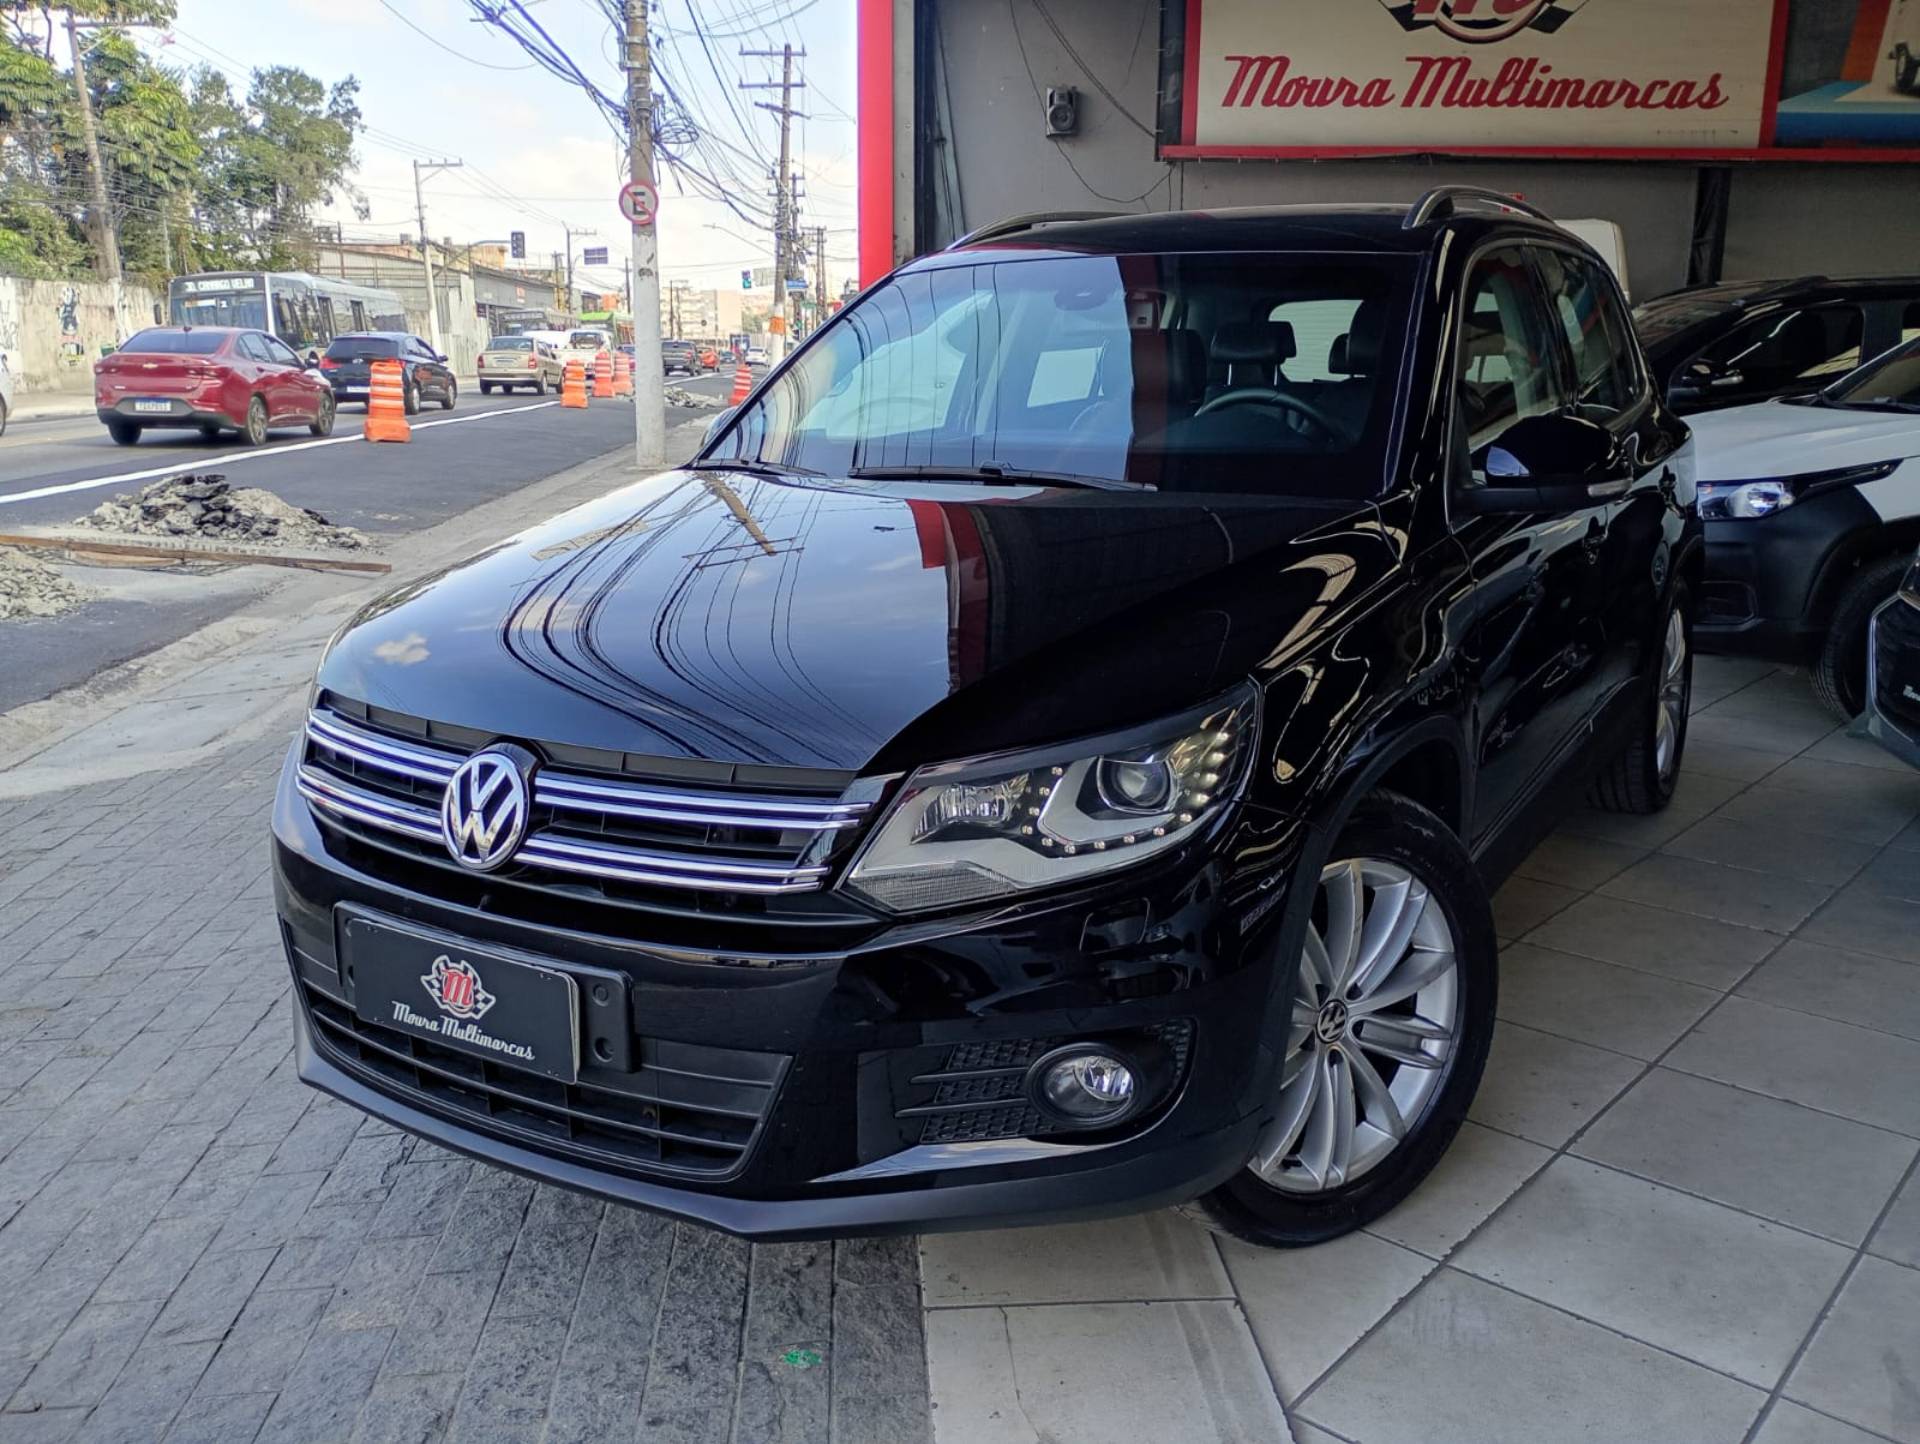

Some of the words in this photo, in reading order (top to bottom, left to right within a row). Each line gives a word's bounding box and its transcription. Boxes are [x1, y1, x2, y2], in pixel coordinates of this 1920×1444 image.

[1222, 55, 1395, 108] Moura
[1400, 56, 1730, 109] Multimarcas
[632, 191, 647, 215] E
[391, 1000, 440, 1032] Moura
[439, 1015, 535, 1061] Multimarcas
